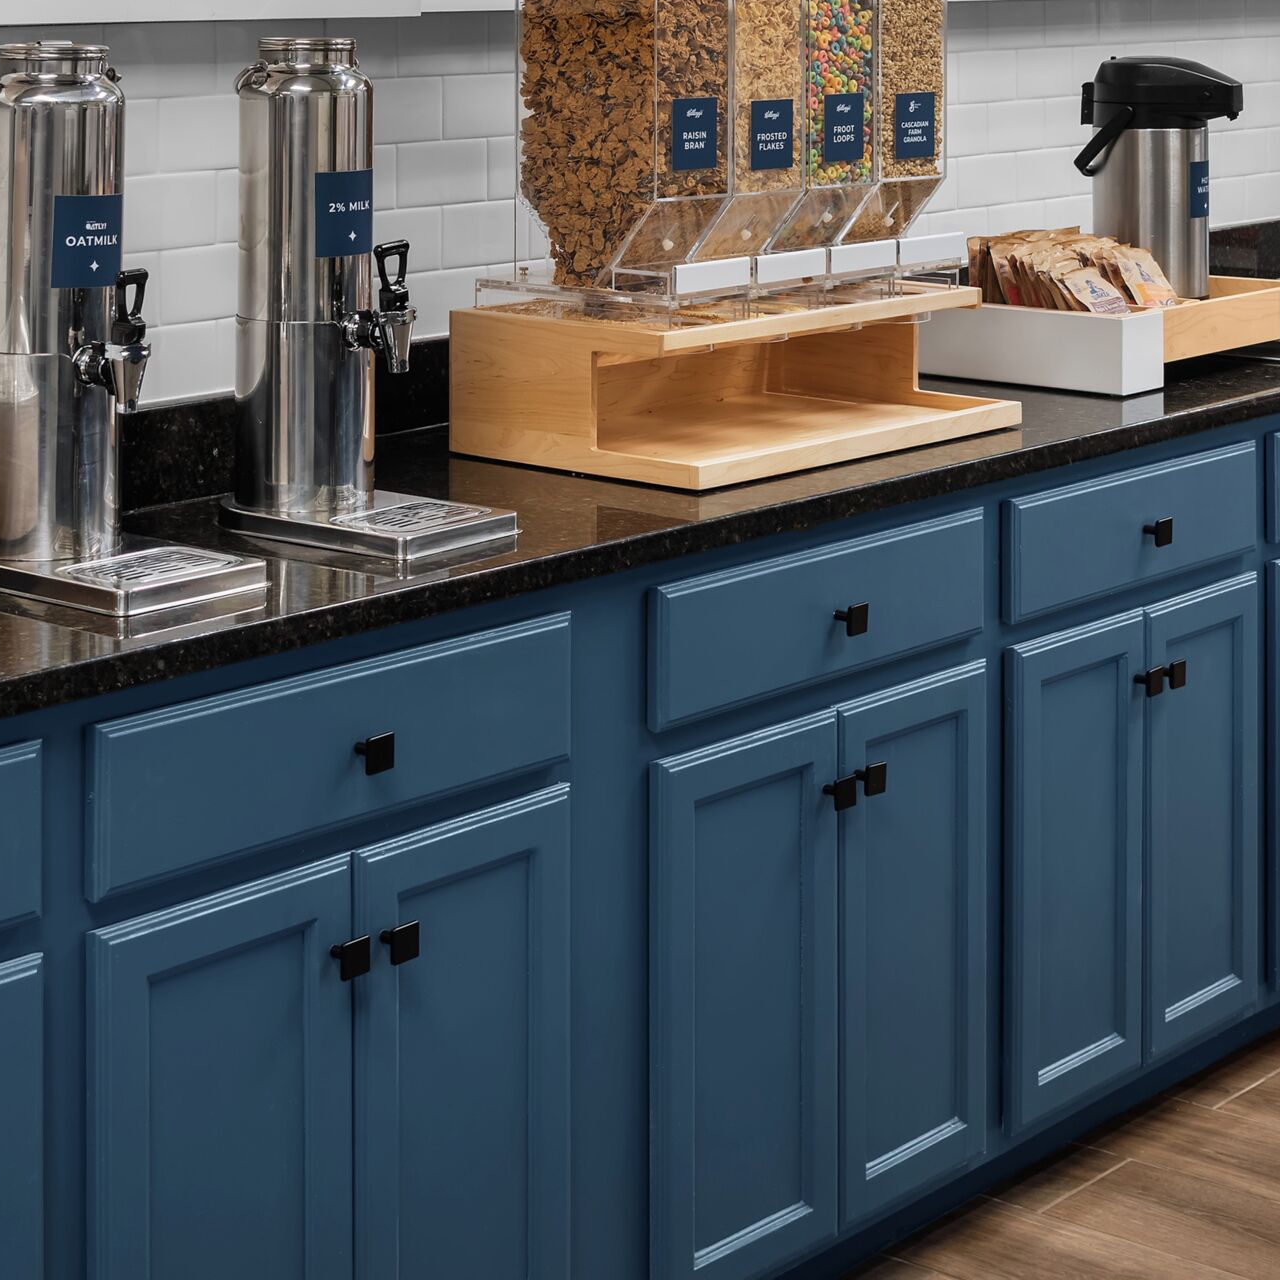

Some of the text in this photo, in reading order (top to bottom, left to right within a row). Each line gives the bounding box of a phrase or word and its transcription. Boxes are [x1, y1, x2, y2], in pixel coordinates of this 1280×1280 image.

[834, 125, 854, 133] FROOT
[683, 131, 707, 139] RAISIN
[757, 132, 787, 141] FROSTED
[685, 142, 704, 150] BRAN
[759, 142, 784, 150] FLAKES
[329, 200, 369, 212] 2% MILK
[66, 234, 117, 246] OATMILK
